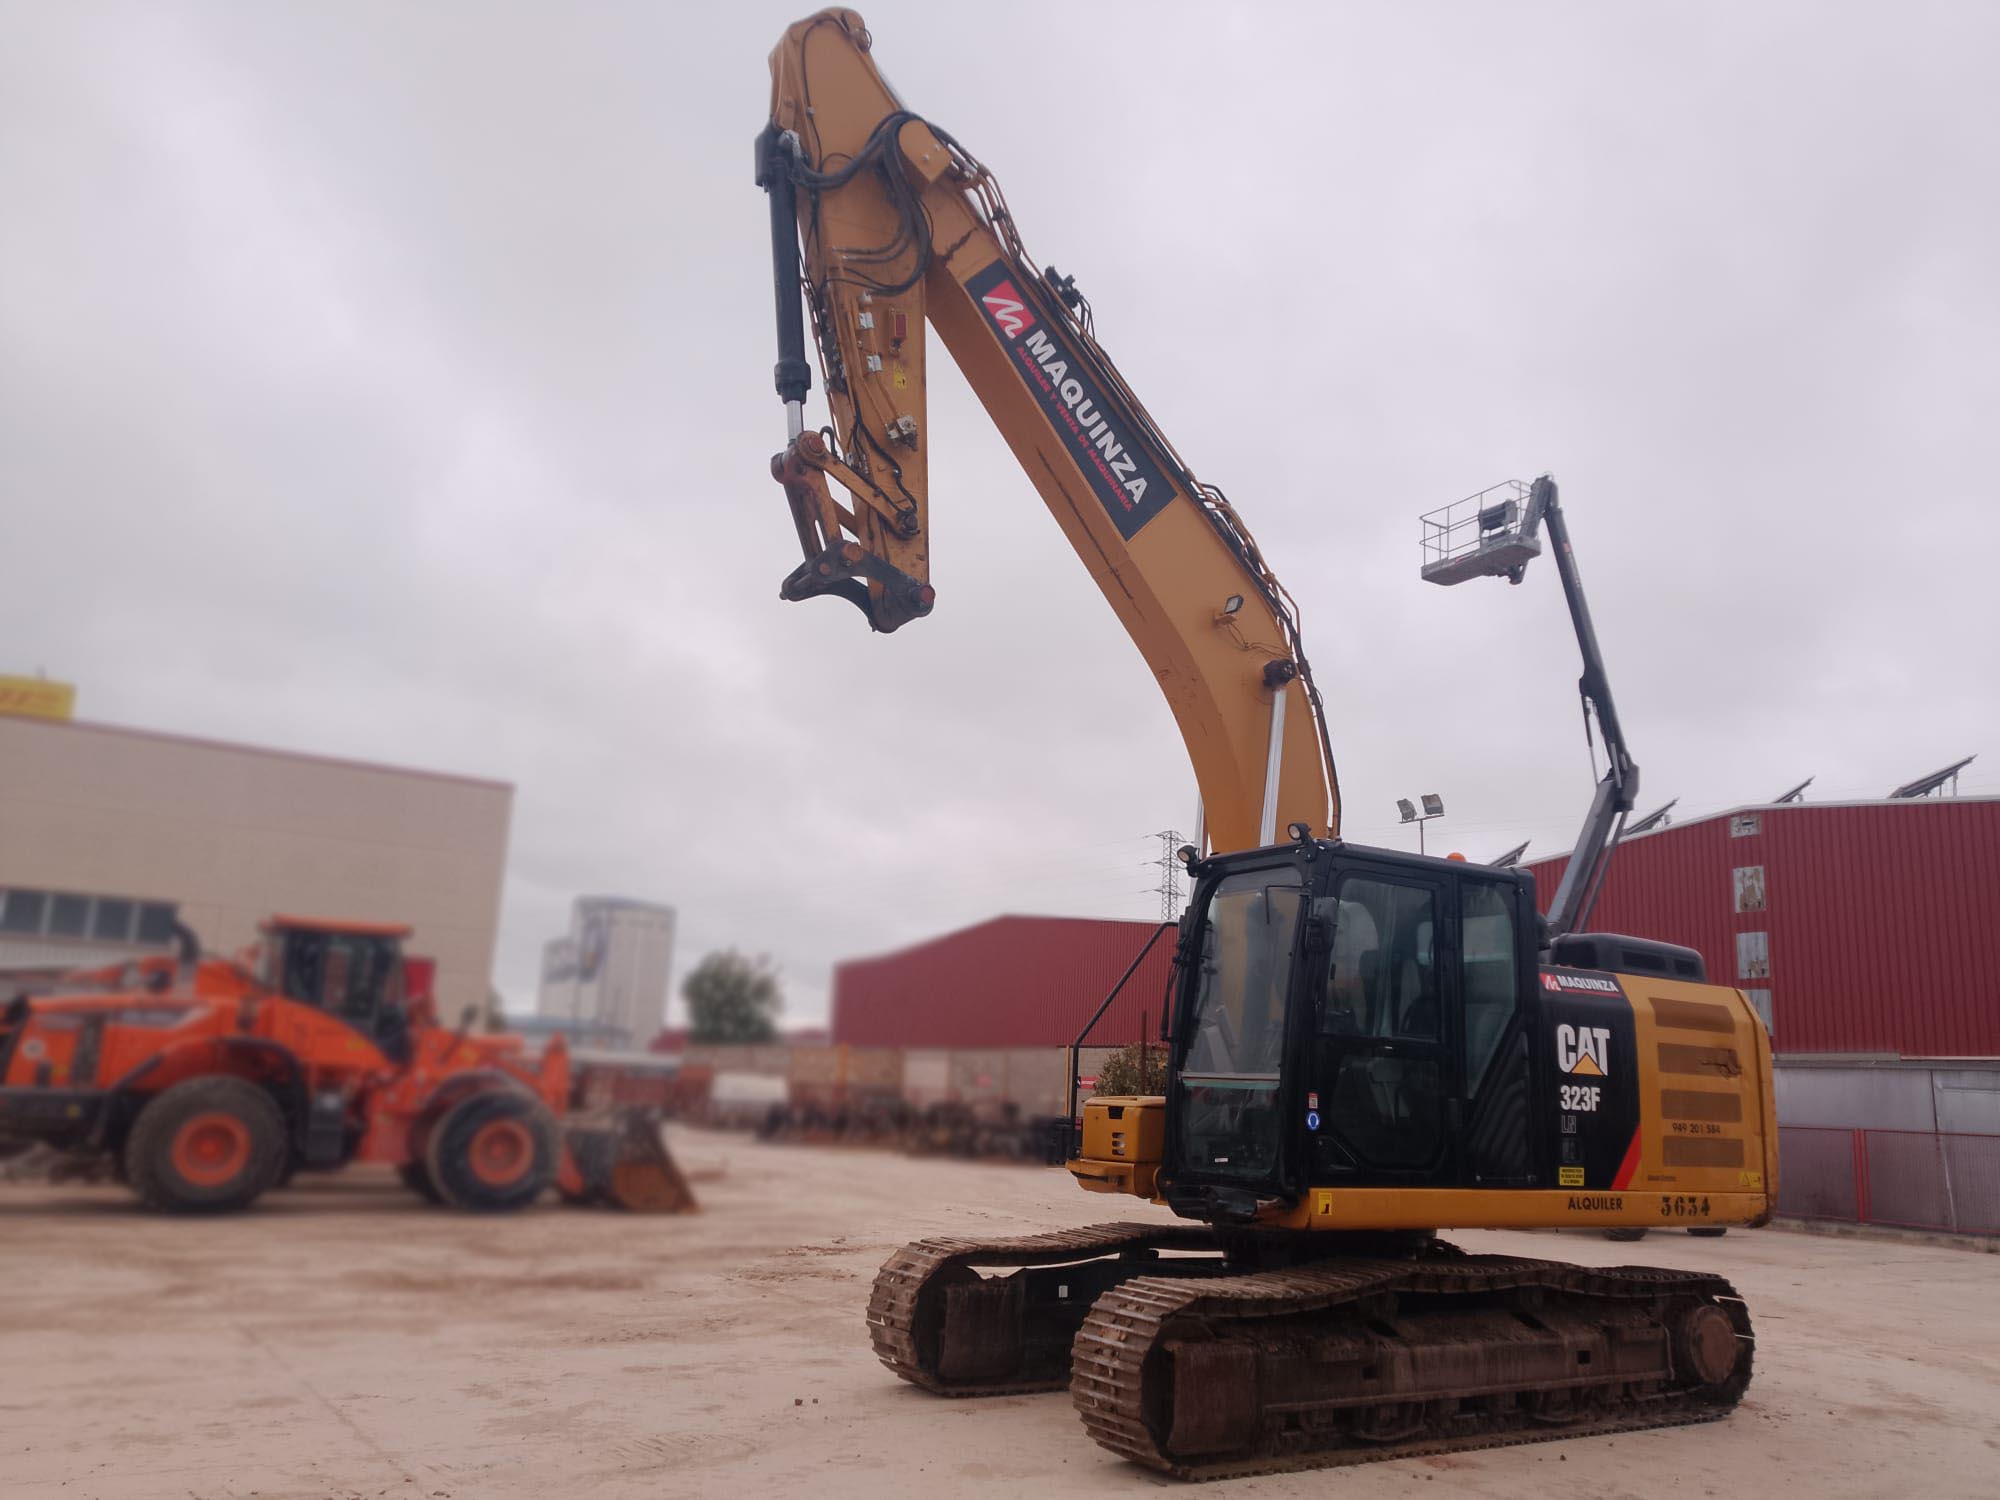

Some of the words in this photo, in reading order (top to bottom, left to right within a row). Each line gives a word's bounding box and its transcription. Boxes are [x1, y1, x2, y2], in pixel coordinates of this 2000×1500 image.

[1025, 329, 1148, 504] MAQUINZA
[1056, 403, 1079, 433] VENTA
[1556, 975, 1620, 993] MAQUINZA
[1557, 1024, 1610, 1077] CAT
[1560, 1085, 1601, 1111] 323F
[1567, 1197, 1623, 1211] ALQUILER
[1661, 1197, 1711, 1217] 3634
